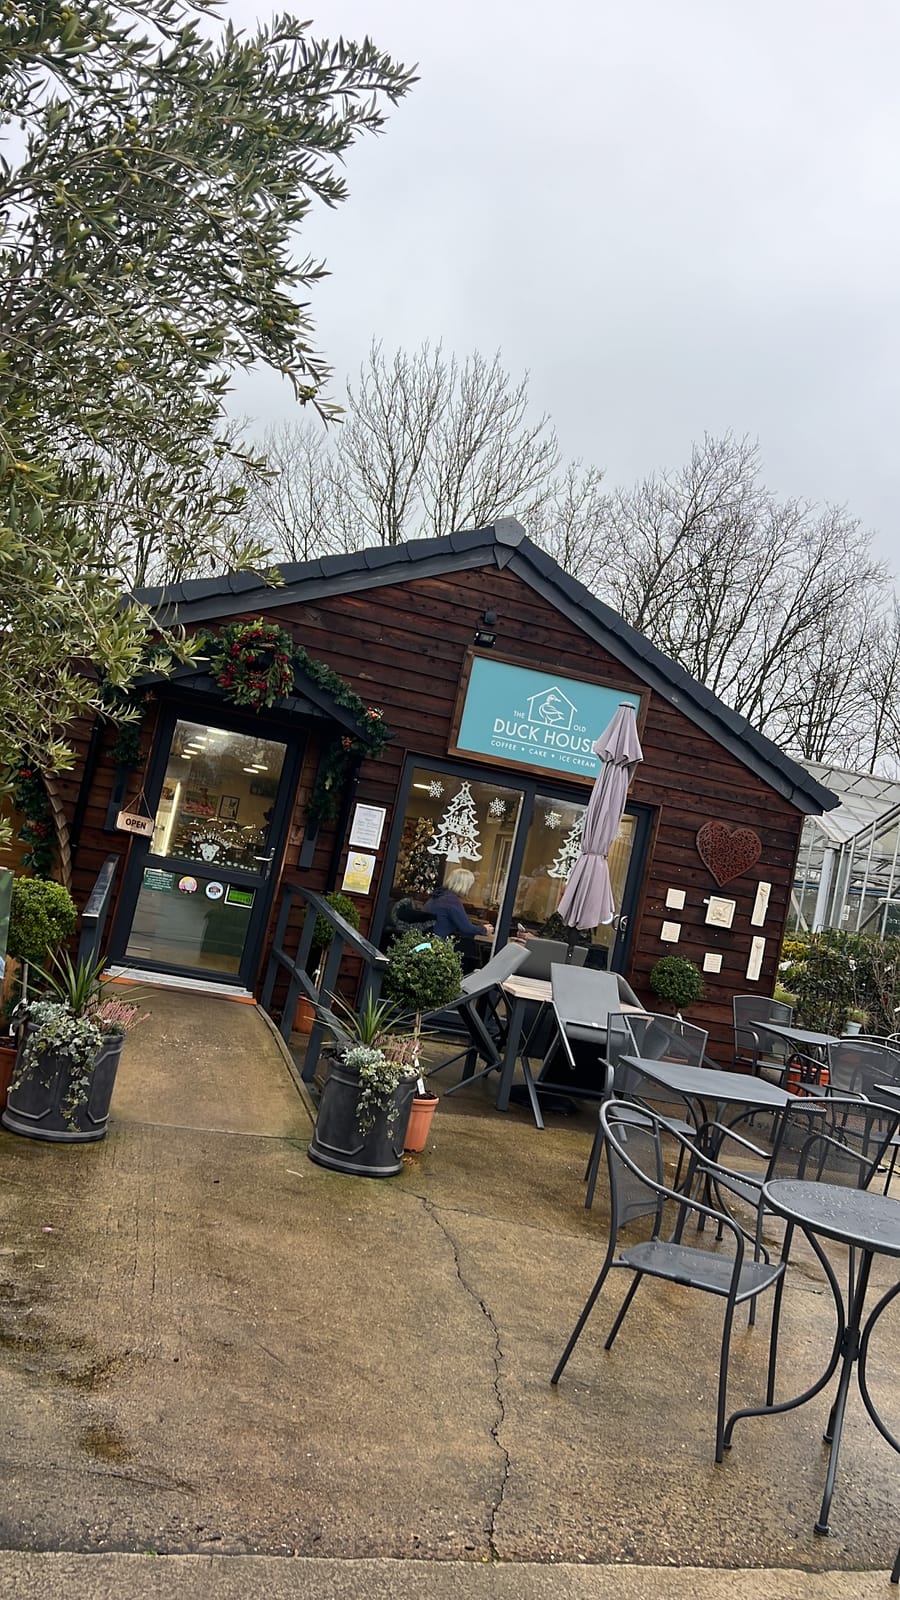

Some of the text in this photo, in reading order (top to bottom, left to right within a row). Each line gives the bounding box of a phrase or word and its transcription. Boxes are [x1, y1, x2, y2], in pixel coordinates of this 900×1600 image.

[513, 710, 525, 718] THE
[493, 718, 541, 742] DUCK
[573, 724, 587, 733] OLD
[490, 740, 596, 768] COFFEE CAKE ICE CREAM
[125, 818, 147, 830] OPEN
